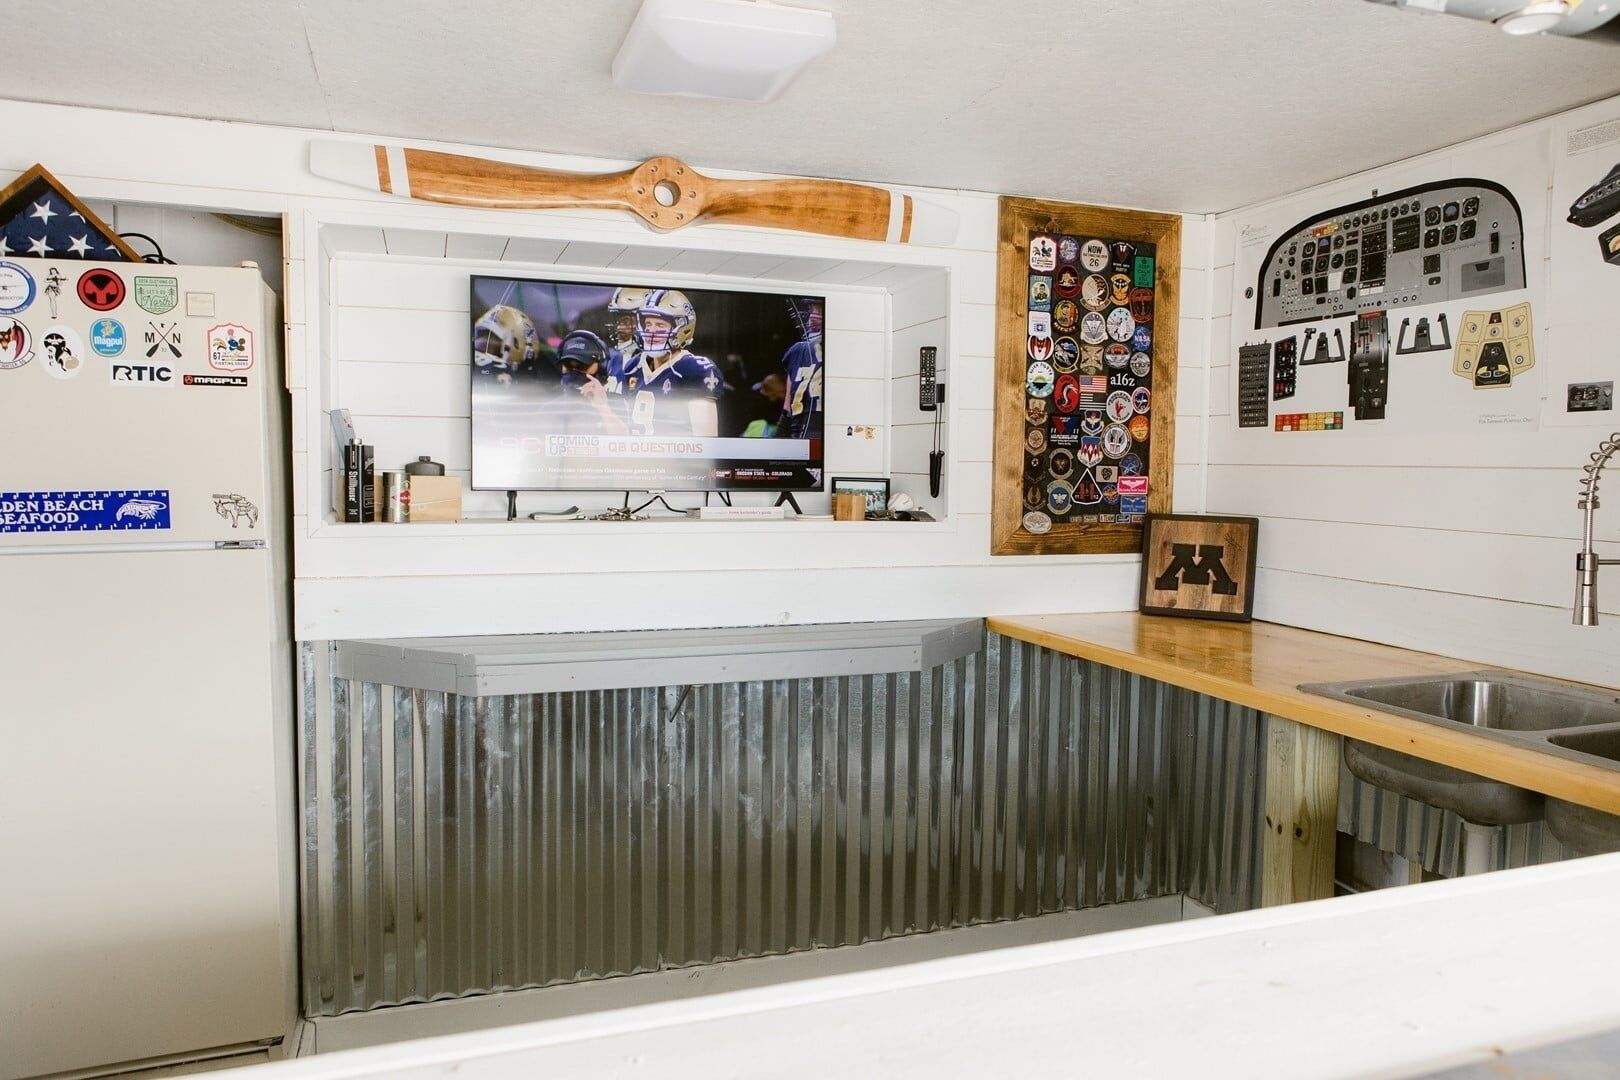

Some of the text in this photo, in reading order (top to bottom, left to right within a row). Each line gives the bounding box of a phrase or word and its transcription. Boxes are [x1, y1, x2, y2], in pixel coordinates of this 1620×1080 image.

[1087, 245, 1103, 254] NOW
[1089, 258, 1100, 267] 26
[94, 336, 122, 347] Magpul
[145, 332, 181, 343] M N
[213, 352, 220, 360] 67
[113, 365, 172, 382] RTIC
[194, 376, 247, 385] MAGPUL
[1110, 373, 1136, 387] a16z
[549, 435, 599, 446] COMING
[550, 446, 567, 455] UP
[608, 441, 627, 454] QB
[630, 442, 703, 454] QUESTIONS
[0, 499, 104, 512] DEN BEACH
[1155, 543, 1238, 595] M
